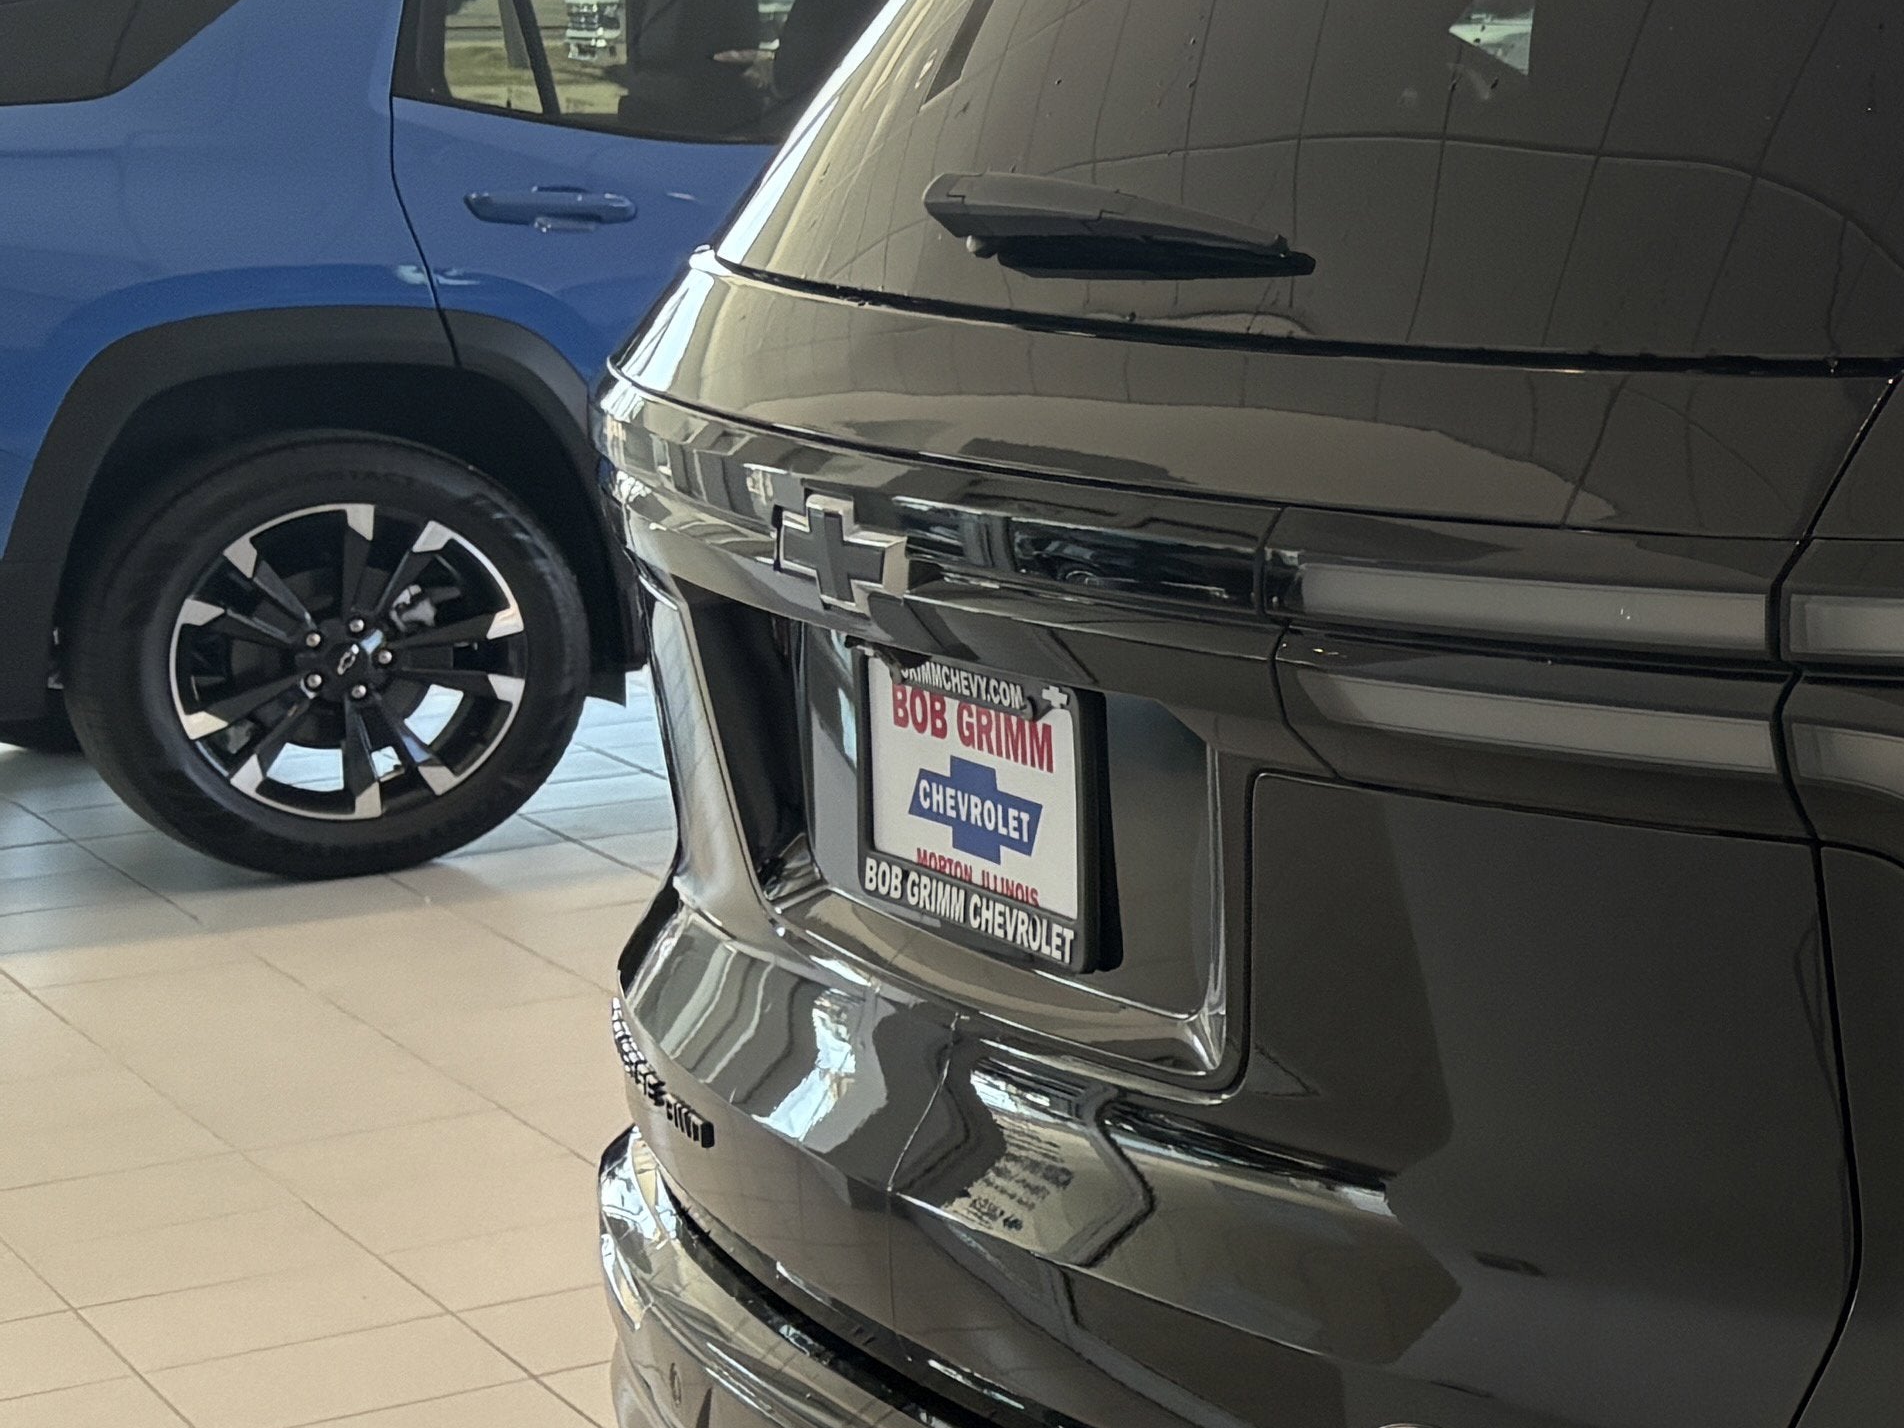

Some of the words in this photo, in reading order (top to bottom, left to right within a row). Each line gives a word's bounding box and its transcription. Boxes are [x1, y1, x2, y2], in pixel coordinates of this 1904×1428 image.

[892, 683, 947, 740] BOB
[956, 701, 1054, 773] GRIMM
[918, 778, 1031, 843] CHEVROLET
[865, 858, 902, 899] BOB
[906, 871, 965, 923] GRIMM
[969, 893, 1075, 965] CHEVROLET
